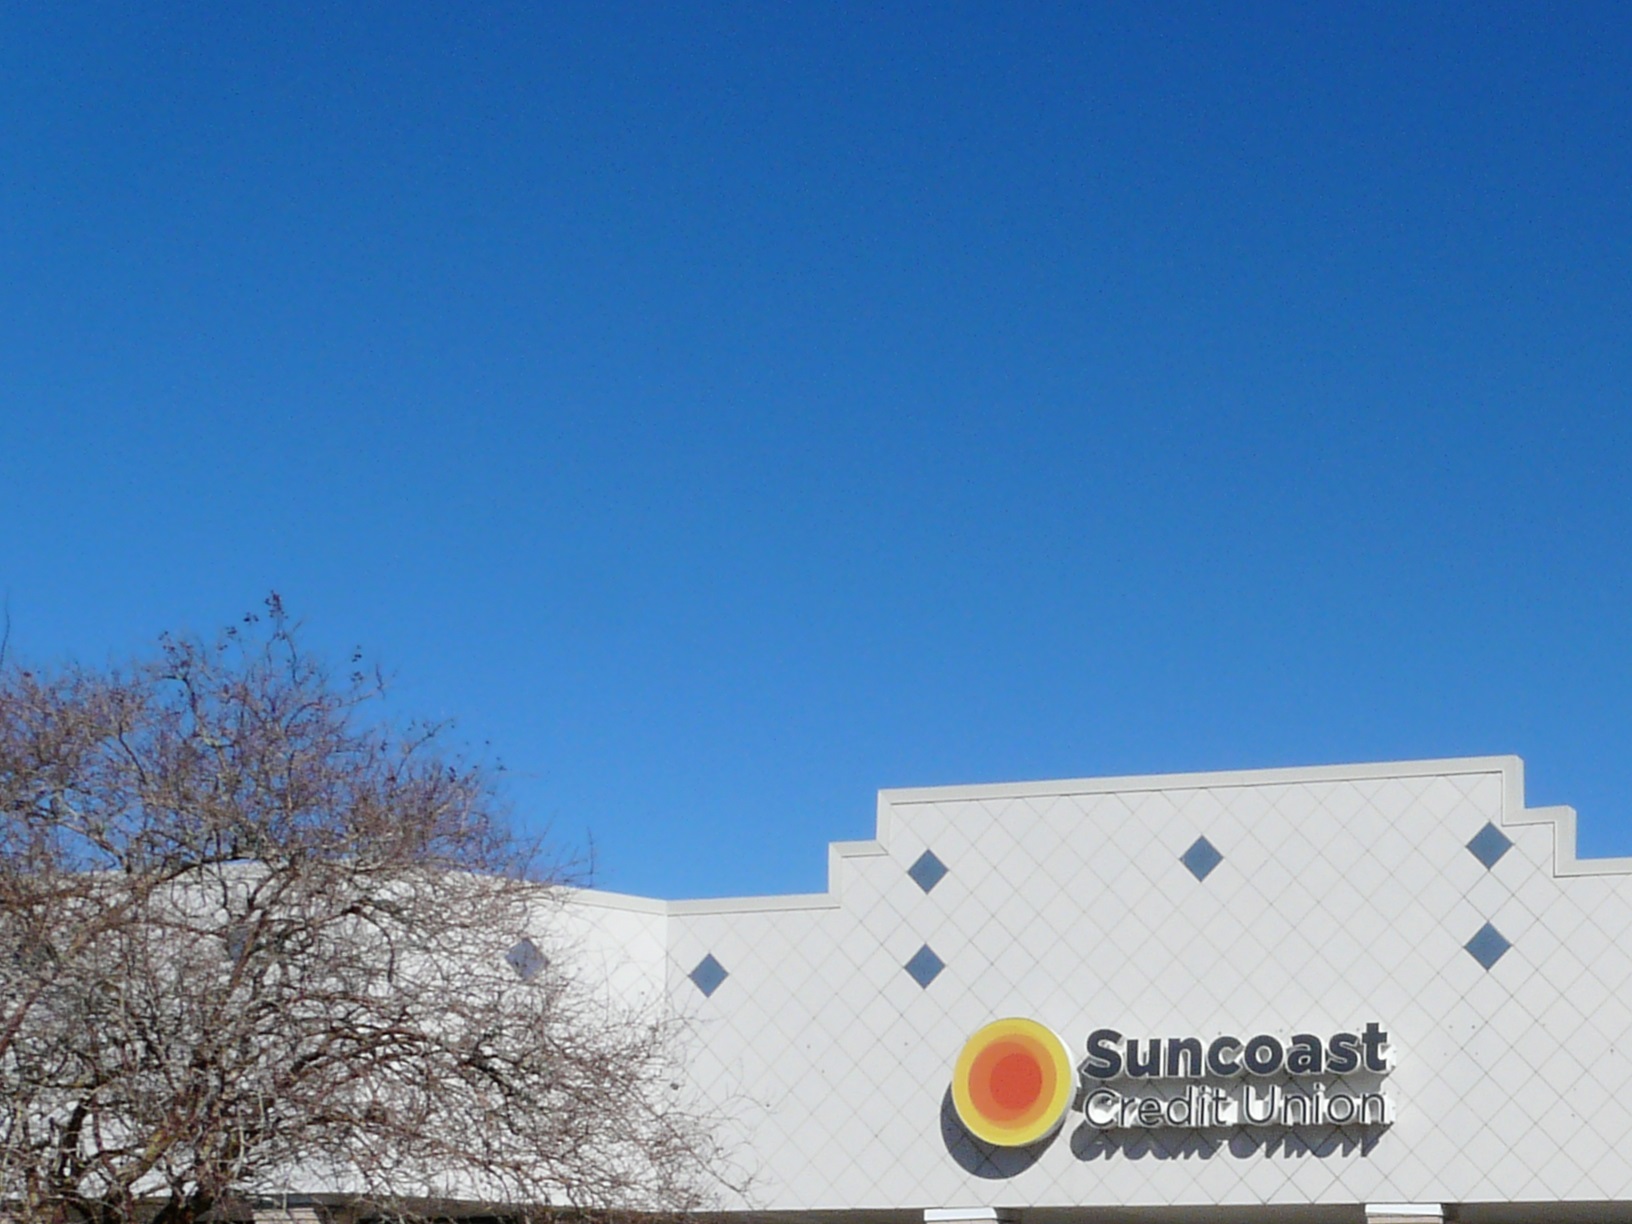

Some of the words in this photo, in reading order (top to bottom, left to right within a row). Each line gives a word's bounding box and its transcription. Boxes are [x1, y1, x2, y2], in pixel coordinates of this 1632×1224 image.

[1082, 1022, 1388, 1078] Suncoast
[1084, 1085, 1227, 1128] Credit
[1243, 1082, 1386, 1124] Union
